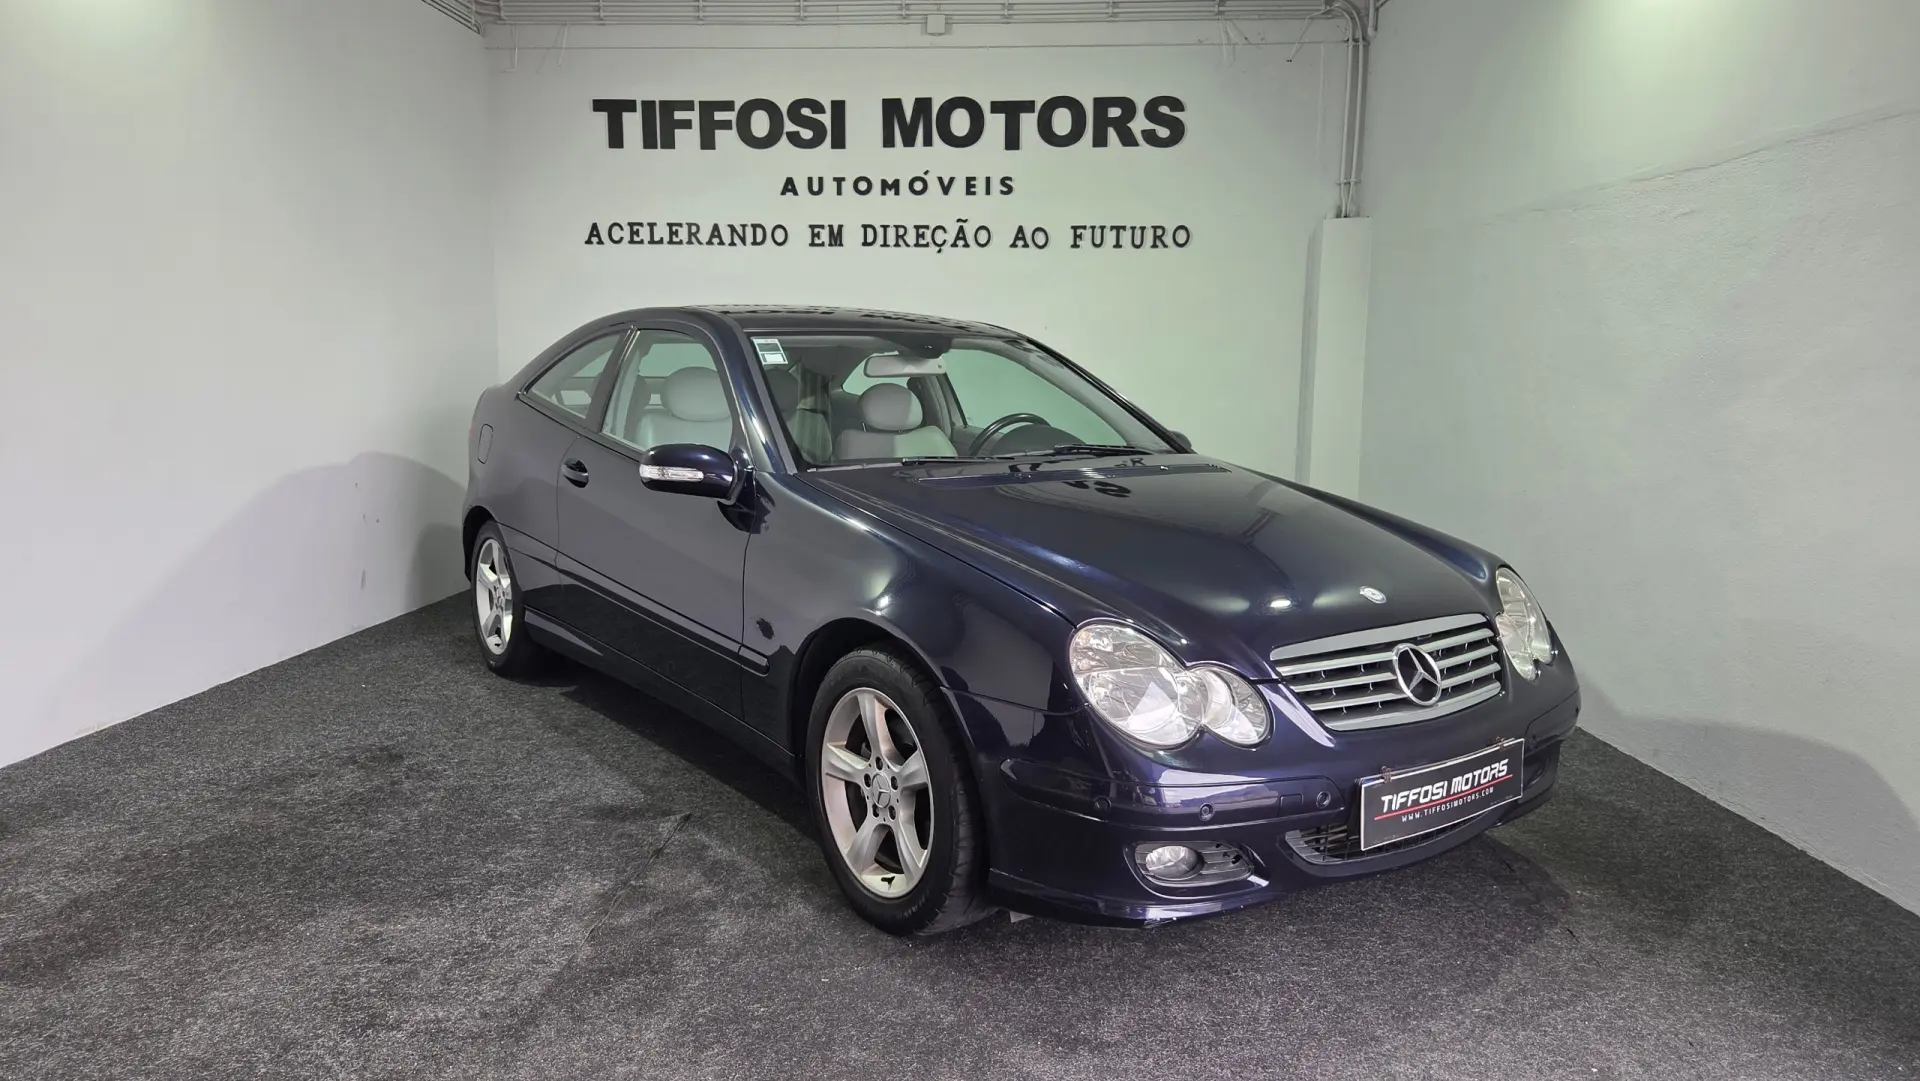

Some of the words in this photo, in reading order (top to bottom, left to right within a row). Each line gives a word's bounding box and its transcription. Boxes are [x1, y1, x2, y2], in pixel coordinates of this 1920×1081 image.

[592, 98, 846, 150] TIFFOSI
[882, 96, 1185, 150] MOTORS
[781, 170, 1014, 196] AUTOMÓVEIS
[585, 222, 788, 247] ACELERANDO
[809, 225, 844, 247] EM
[862, 219, 991, 253] DIREÇÃO
[1010, 226, 1050, 249] AO
[1071, 225, 1190, 249] FUTURO
[1381, 781, 1448, 812] TIFFOSI
[1451, 759, 1509, 793] MOTORS
[1401, 787, 1494, 822] WWW.TIFFOSIMOTORS.COM
